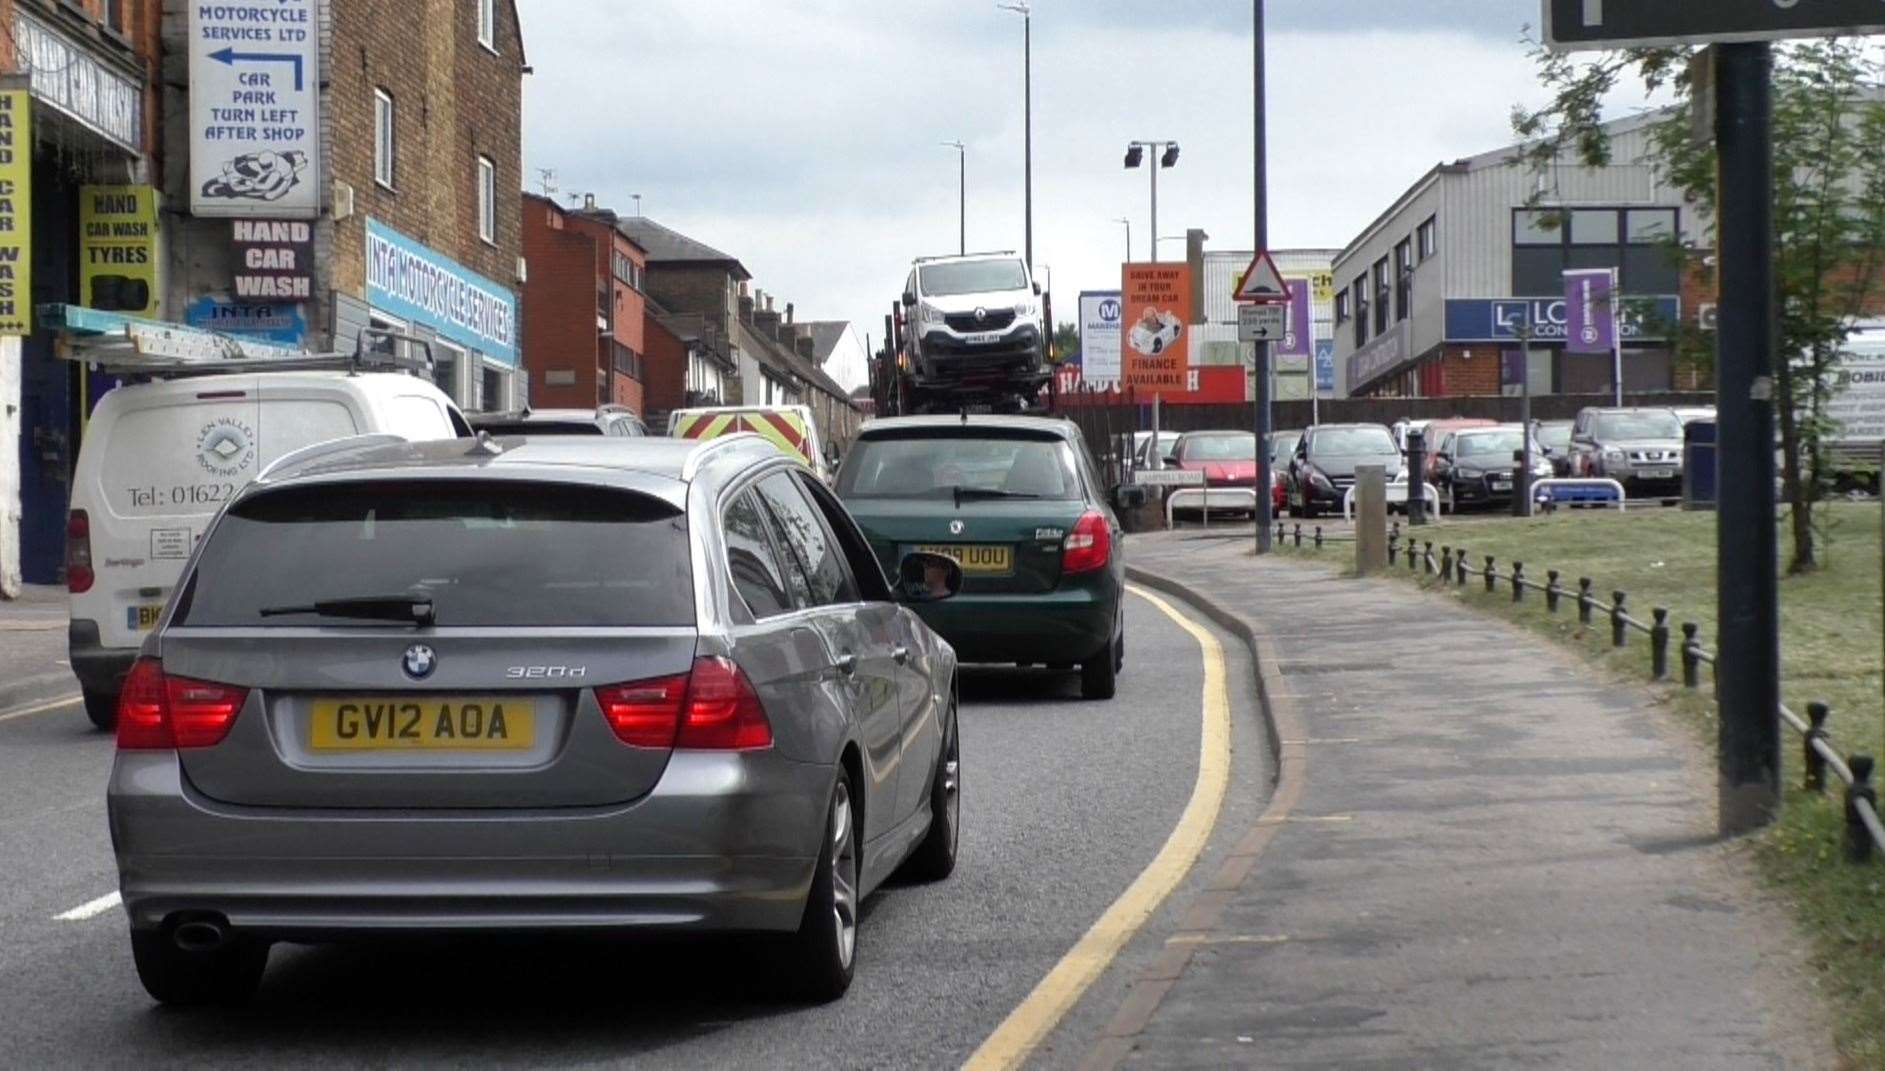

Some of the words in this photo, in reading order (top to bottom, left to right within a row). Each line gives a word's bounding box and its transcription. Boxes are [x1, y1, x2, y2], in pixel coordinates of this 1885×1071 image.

[199, 6, 308, 22] MOTORCYCLE
[202, 26, 272, 40] SERVICES
[278, 28, 306, 41] LTD
[239, 72, 271, 87] CAR
[233, 90, 276, 105] PARK
[210, 108, 255, 122] TURN
[261, 109, 298, 123] LEFT
[205, 126, 257, 141] AFTER
[263, 127, 305, 141] SHOP
[94, 194, 137, 214] HAND
[86, 222, 110, 237] CAR
[112, 222, 148, 236] WASH
[233, 220, 310, 242] HAND
[87, 246, 148, 264] TYRES
[245, 247, 295, 269] CAR
[1158, 271, 1180, 280] AWAY
[234, 275, 310, 297] WASH
[366, 231, 397, 298] INTA
[398, 247, 467, 326] MOTORCYCLE
[466, 282, 510, 347] SERVICES
[1137, 283, 1146, 291] IN
[1150, 282, 1172, 291] YOUR
[1130, 294, 1159, 303] DREAM
[1162, 294, 1179, 303] CAR
[1131, 358, 1177, 370] FINANCE
[1126, 374, 1182, 385] AVAILABLE
[127, 486, 165, 507] Tel:
[171, 483, 235, 504] 01622
[506, 664, 587, 678] 320d
[336, 703, 422, 739] GV12
[434, 703, 508, 739] AOA
